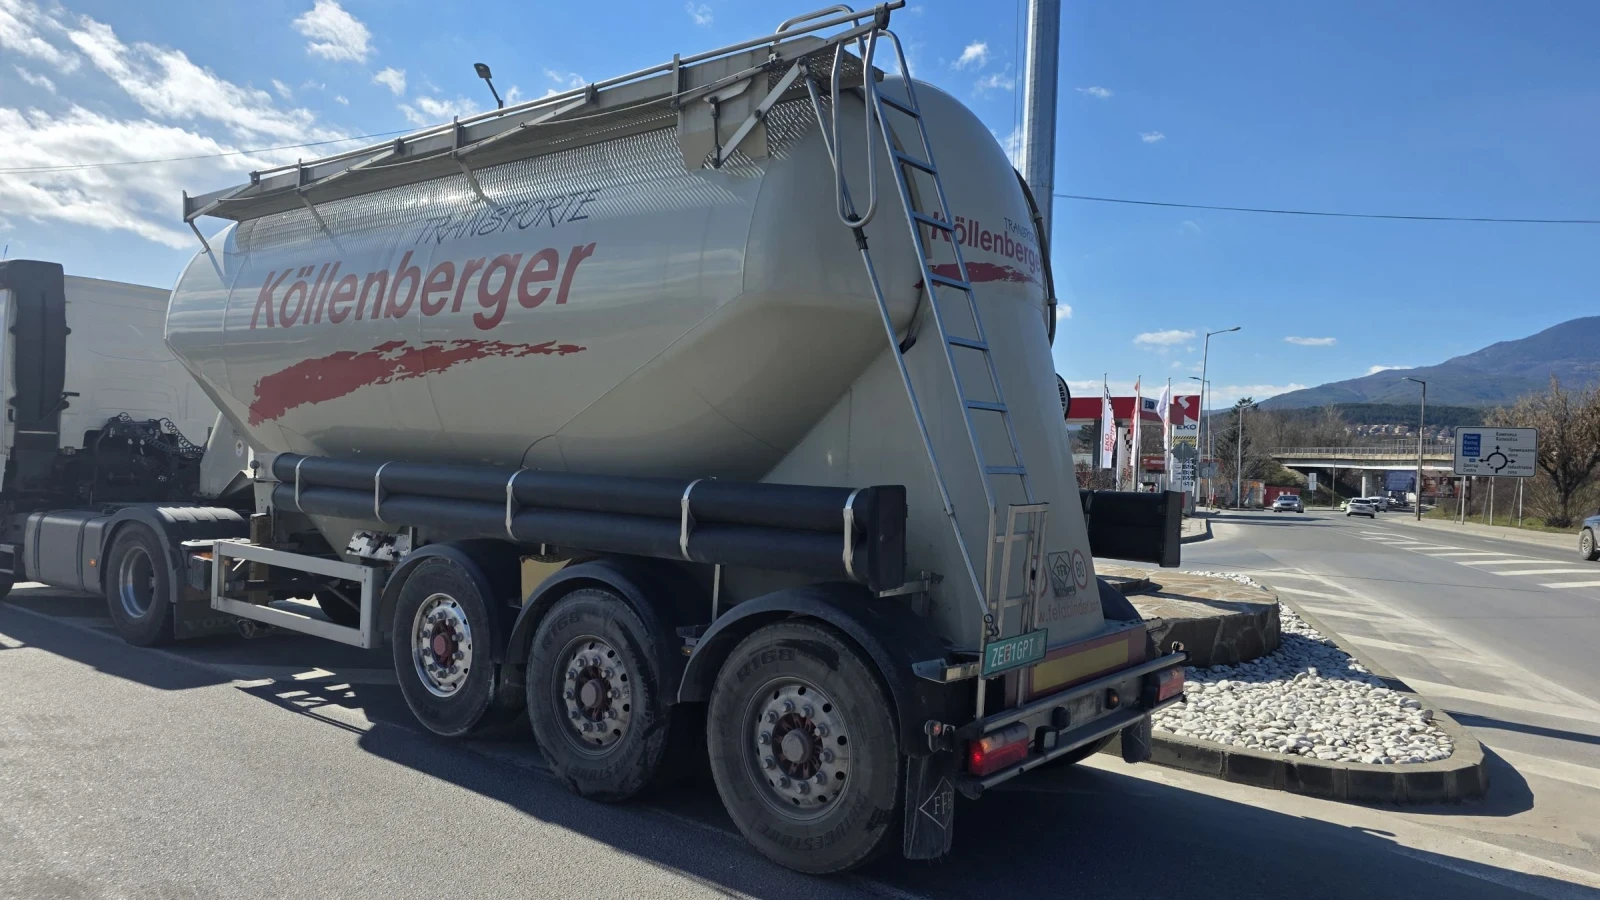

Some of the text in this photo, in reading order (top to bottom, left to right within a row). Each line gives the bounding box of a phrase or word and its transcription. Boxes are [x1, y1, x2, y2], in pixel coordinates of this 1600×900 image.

[415, 189, 601, 245] TRANSPORTE
[250, 242, 597, 331] Köllenberger
[736, 647, 796, 684] R168
